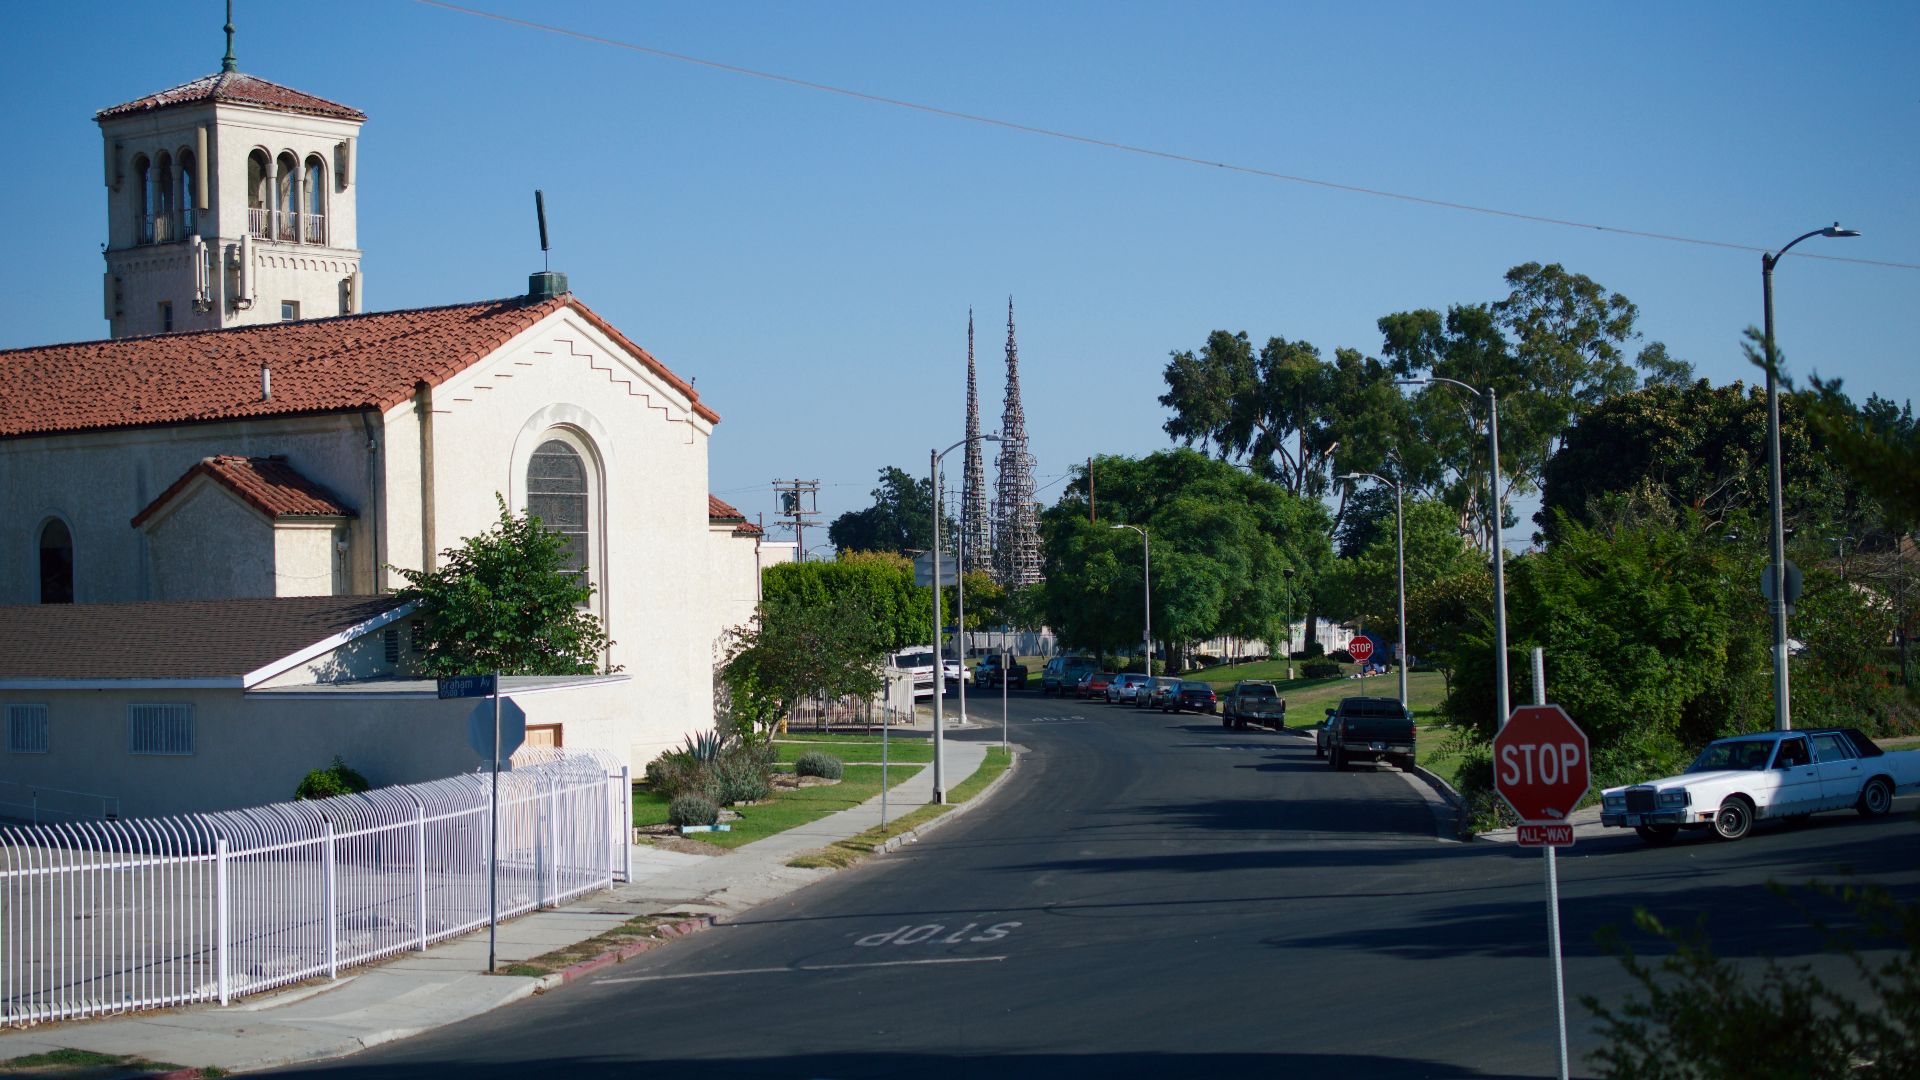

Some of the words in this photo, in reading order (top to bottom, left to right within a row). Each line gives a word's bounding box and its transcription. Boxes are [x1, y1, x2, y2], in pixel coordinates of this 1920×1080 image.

[1350, 643, 1371, 653] STOP
[440, 679, 473, 689] Graham
[480, 677, 491, 688] Av
[1501, 743, 1580, 786] STOP
[1519, 827, 1572, 842] ALL-WAY
[854, 921, 1022, 947] STOP
